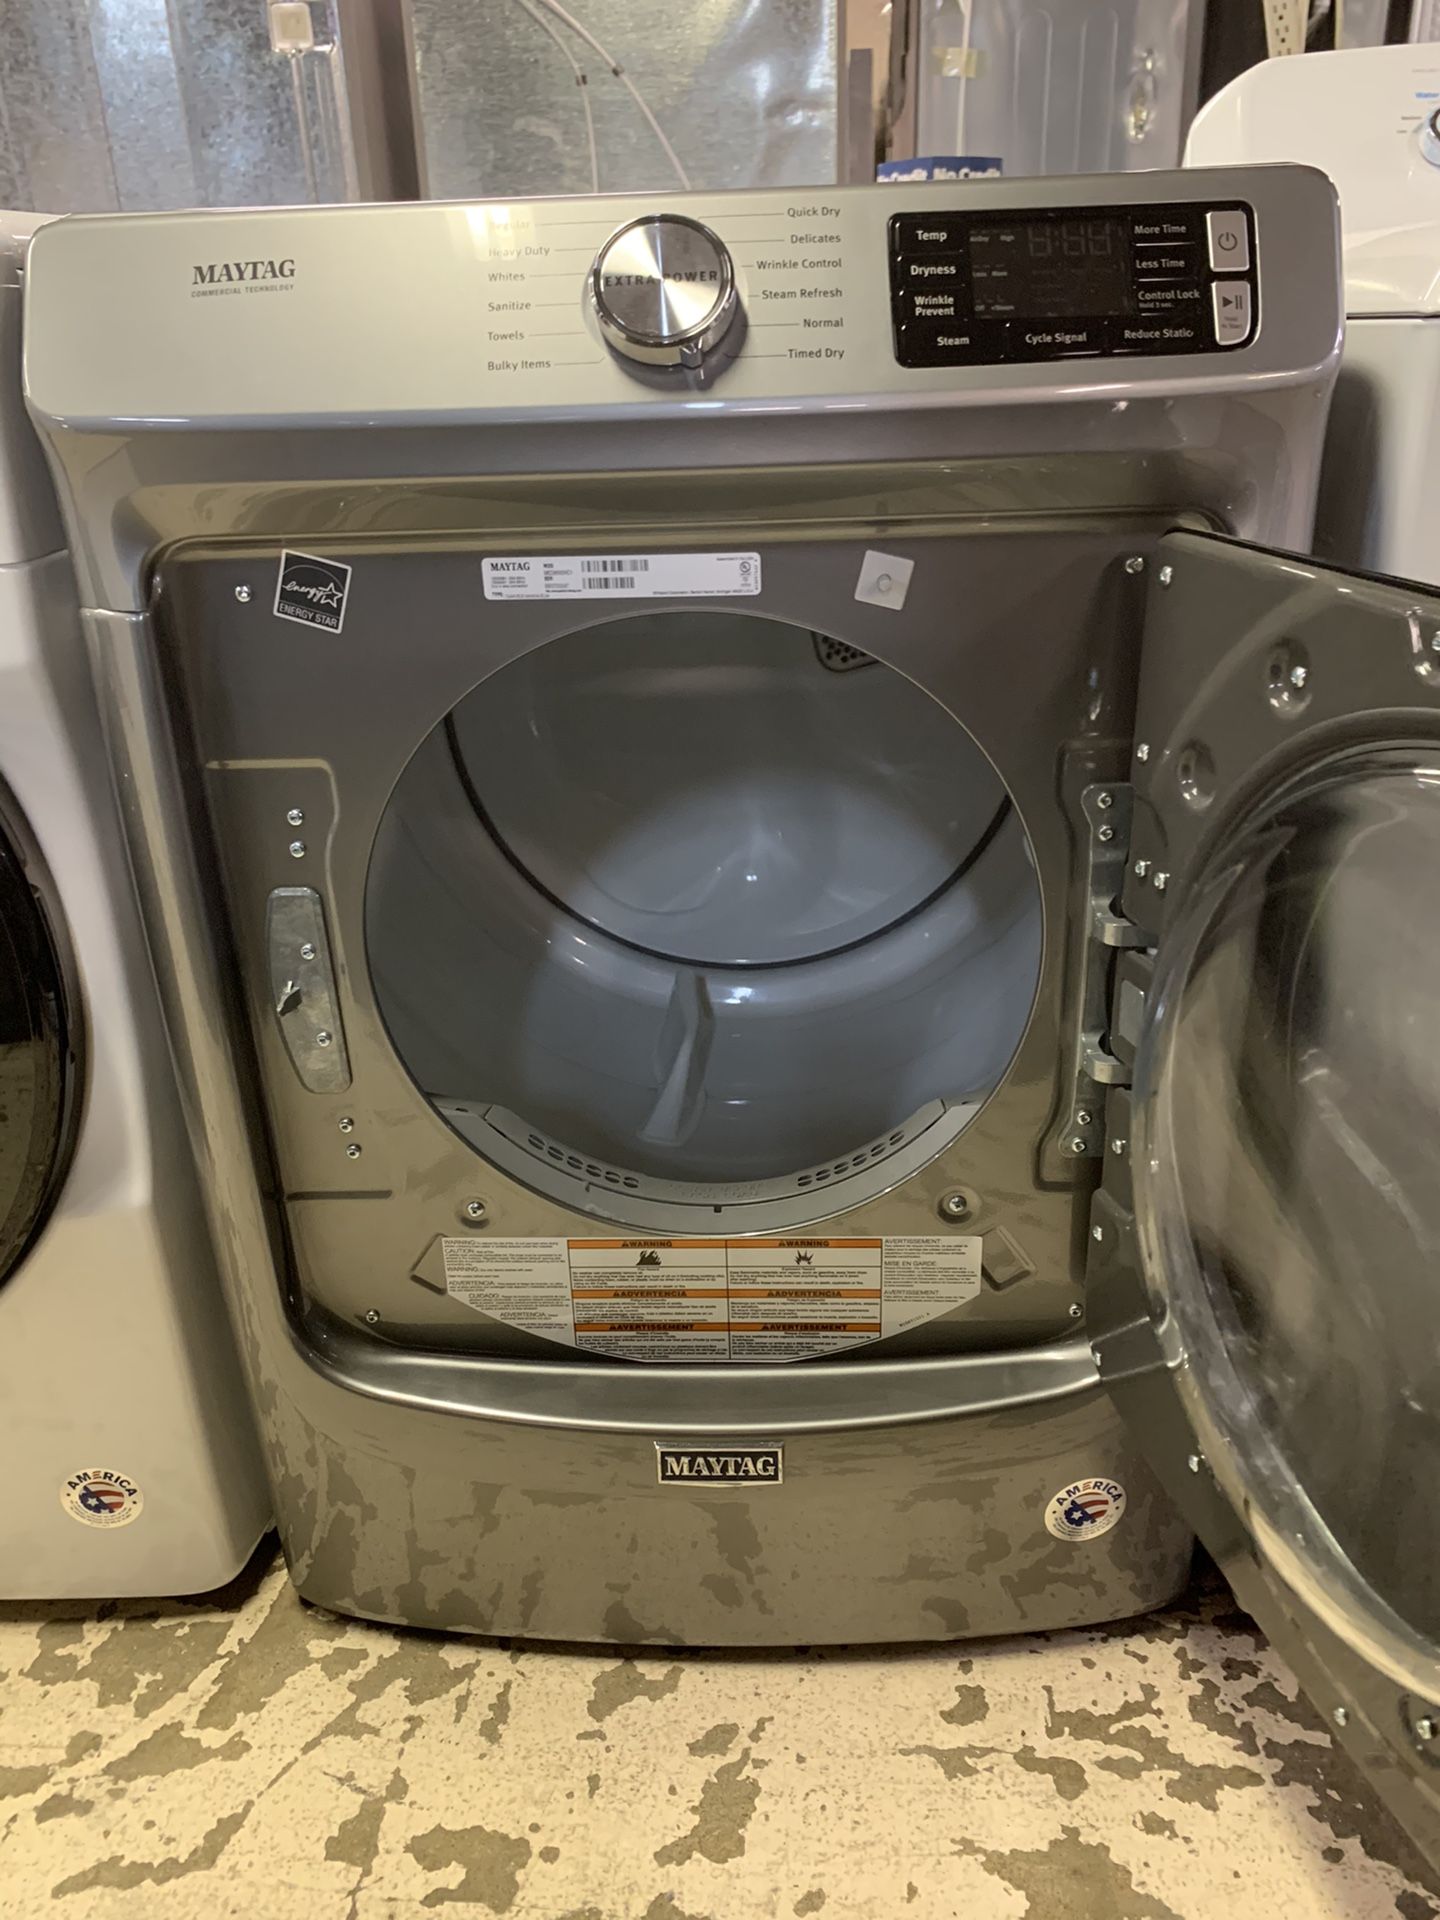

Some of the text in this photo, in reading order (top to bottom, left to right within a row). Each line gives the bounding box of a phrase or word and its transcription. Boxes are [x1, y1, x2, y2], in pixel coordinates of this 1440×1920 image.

[787, 206, 841, 218] Quick Dry
[1134, 224, 1187, 235] More Time
[790, 233, 841, 244] Delicates
[915, 230, 948, 242] Temp
[524, 246, 551, 256] Duty
[756, 257, 842, 270] Wrinkle Control
[1136, 259, 1186, 269] Less Time
[192, 259, 296, 284] MAYTAG
[910, 264, 957, 277] Dryness
[488, 272, 526, 282] Whites
[604, 271, 718, 287] EXTRA POWER
[191, 284, 295, 298] COMMERCIAL TECHNOLOGY
[761, 287, 842, 300] Steam Refresh
[1138, 290, 1201, 301] Control Lock
[488, 300, 532, 312] Sanitize
[914, 295, 955, 305] Wrinkle
[915, 306, 955, 316] Prevent
[803, 316, 844, 328] Normal
[488, 330, 525, 341] Towels
[1025, 332, 1087, 345] Cycle Signal
[1124, 328, 1194, 339] Reduce Static
[937, 336, 970, 346] Steam
[788, 348, 845, 360] Timed Dry
[487, 360, 552, 372] Bulky Items
[490, 562, 531, 571] MAYTAG
[279, 602, 338, 628] ENERGY STAR
[630, 1240, 673, 1248] WARNING
[775, 1290, 842, 1298] ADVERTENCIA
[614, 1324, 695, 1332] AVERTISSEMENT
[769, 1323, 848, 1332] AVERTISSEMENT
[664, 1456, 776, 1476] MAYTAG
[67, 1470, 138, 1497] AMERICA
[1056, 1481, 1123, 1507] AMERICA
